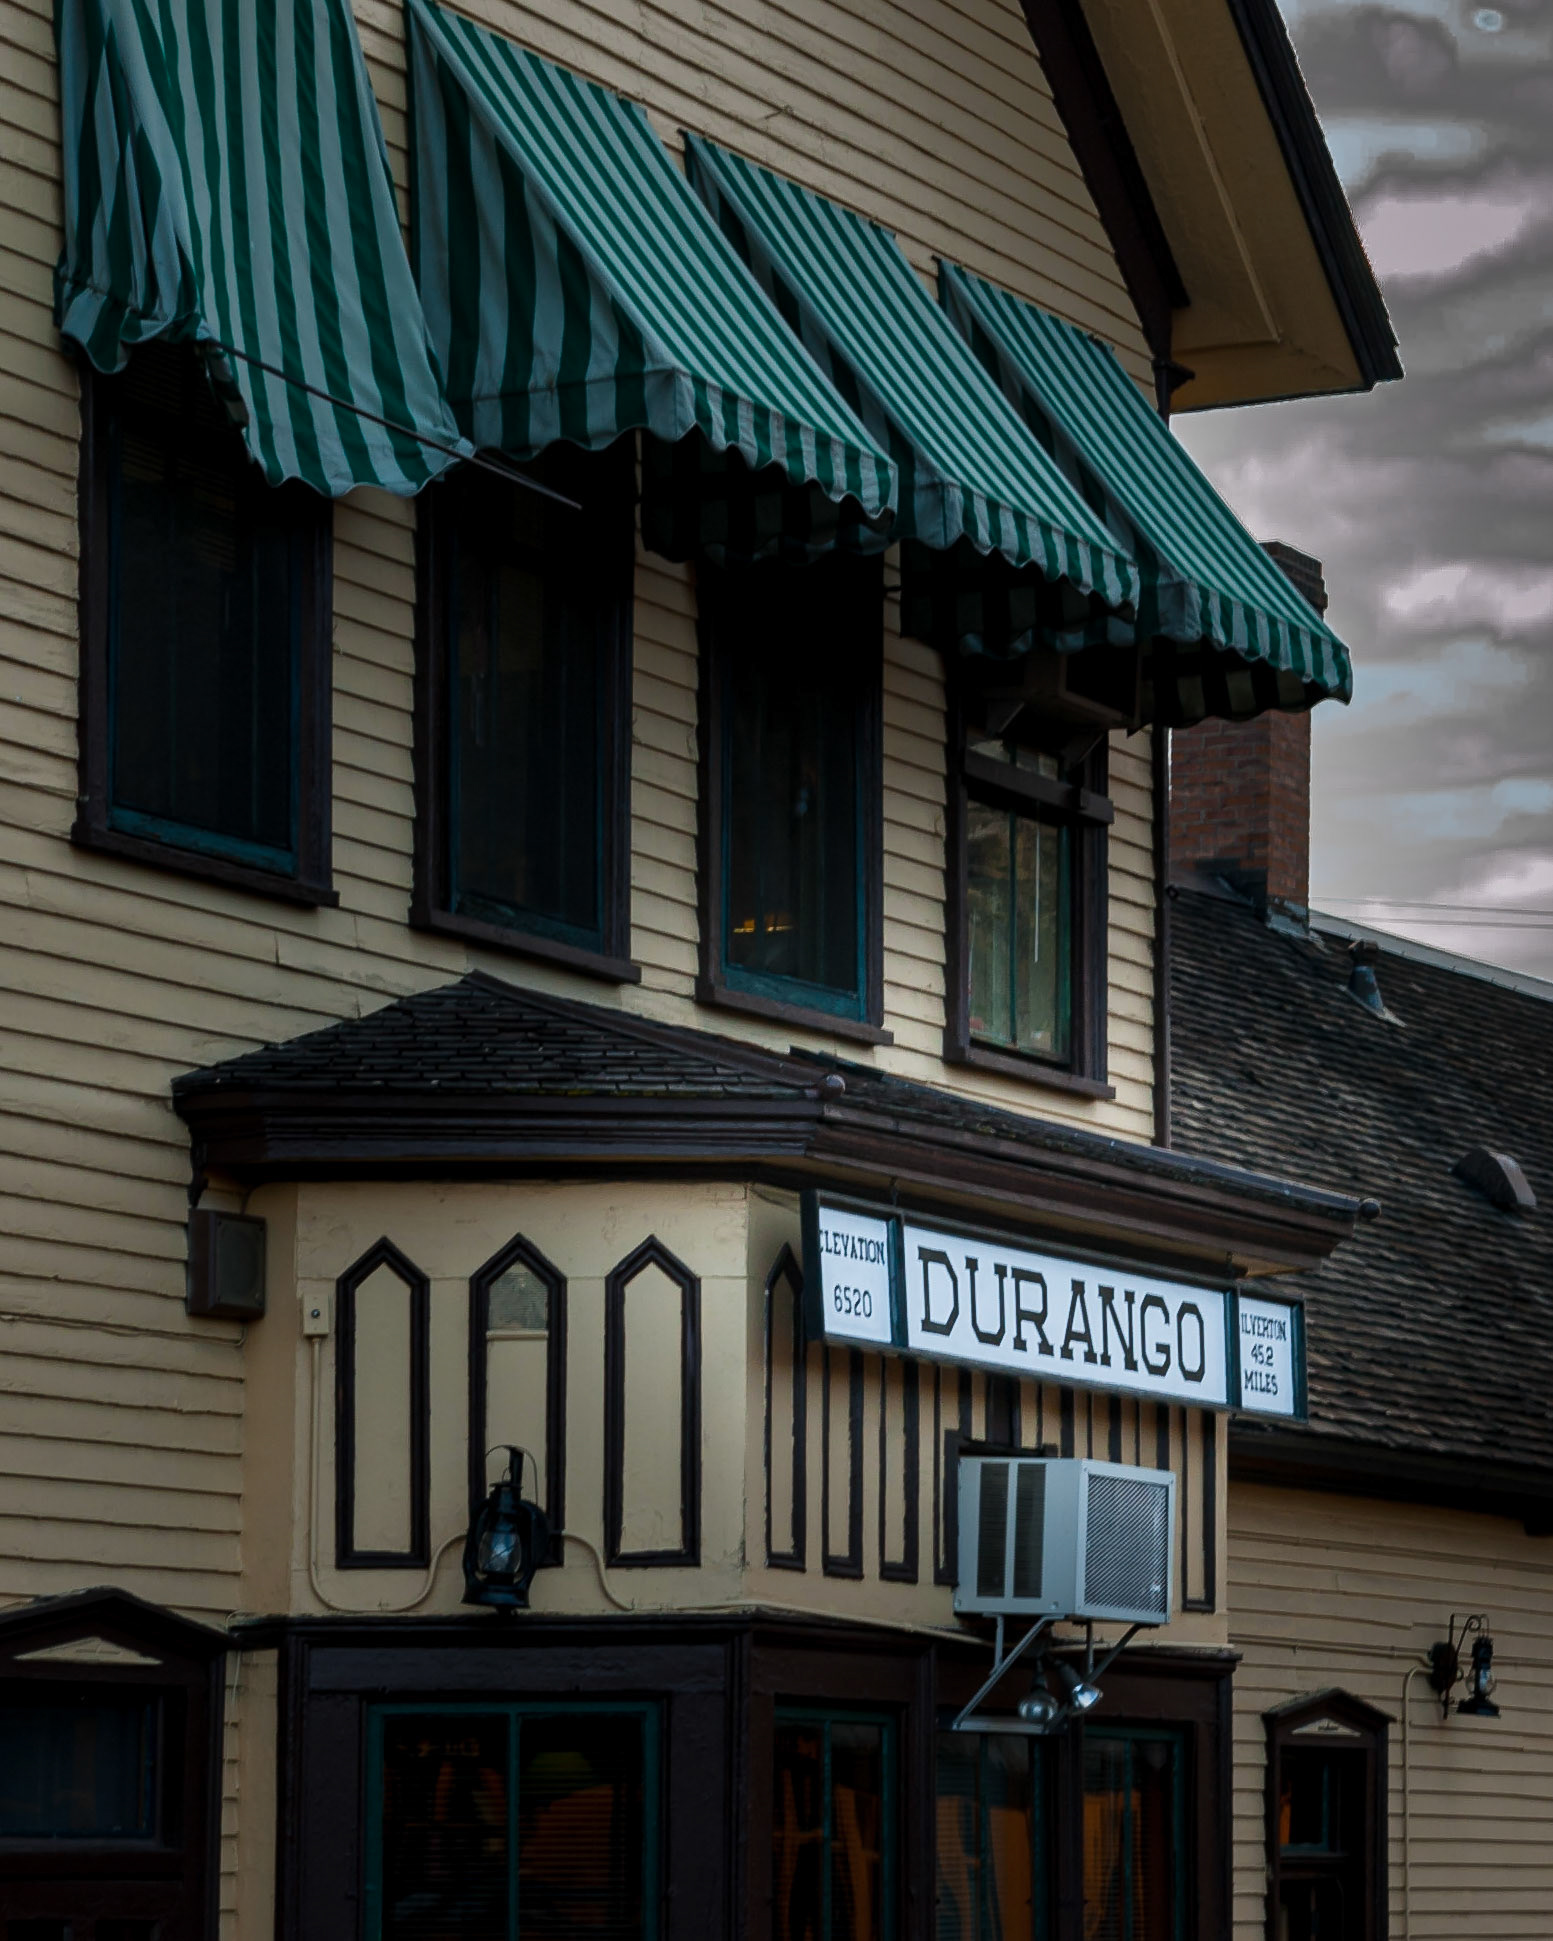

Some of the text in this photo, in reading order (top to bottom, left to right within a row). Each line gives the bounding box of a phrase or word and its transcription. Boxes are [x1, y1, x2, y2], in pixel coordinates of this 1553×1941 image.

[834, 1283, 872, 1318] 6520
[918, 1246, 1206, 1383] DURANGO
[1240, 1312, 1286, 1341] ILVERTON
[1244, 1368, 1278, 1396] MILES
